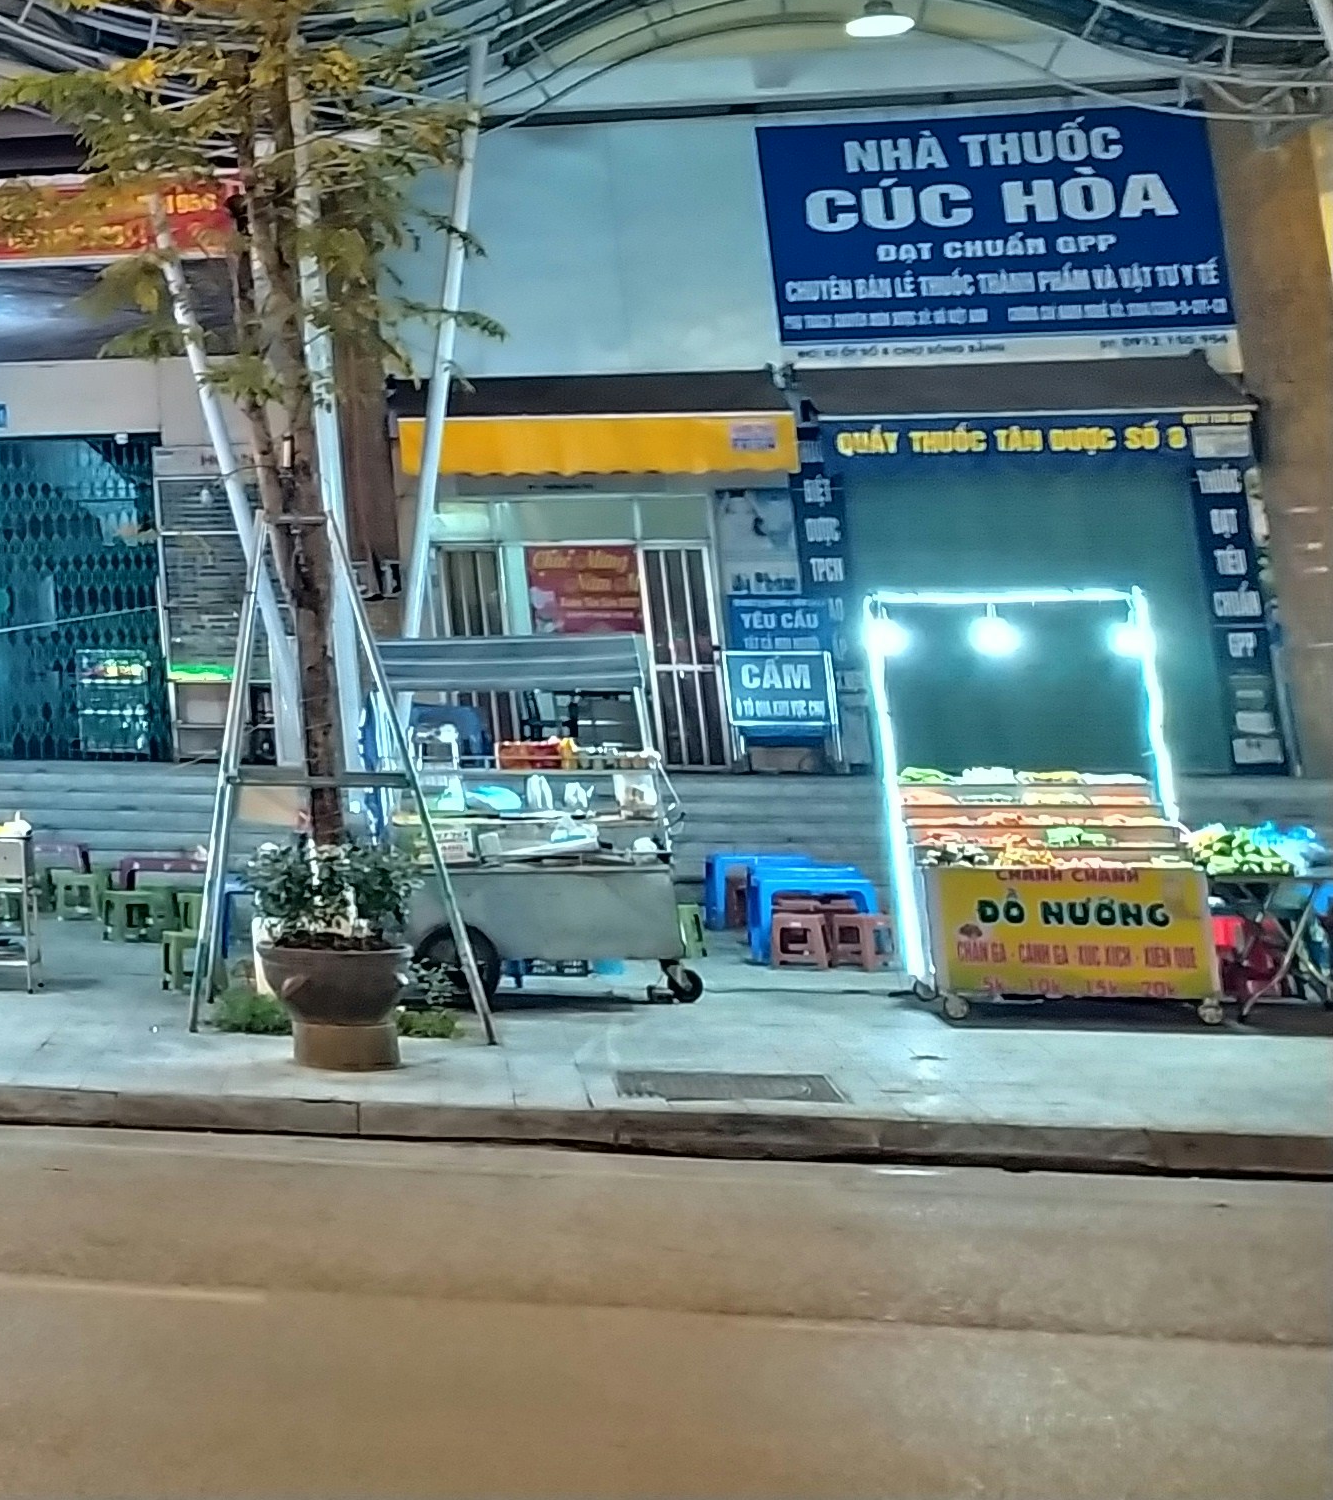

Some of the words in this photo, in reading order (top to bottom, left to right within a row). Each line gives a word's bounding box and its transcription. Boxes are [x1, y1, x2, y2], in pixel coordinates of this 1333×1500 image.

[843, 130, 950, 173] NHÀ
[958, 115, 1124, 168] THUỐC
[805, 178, 974, 232] CÚC
[1000, 166, 1180, 224] HÒA
[740, 611, 776, 630] YÊU
[740, 655, 812, 690] CẤM
[977, 887, 1026, 924] ĐỒ
[1039, 894, 1171, 927] NƯỚNG
